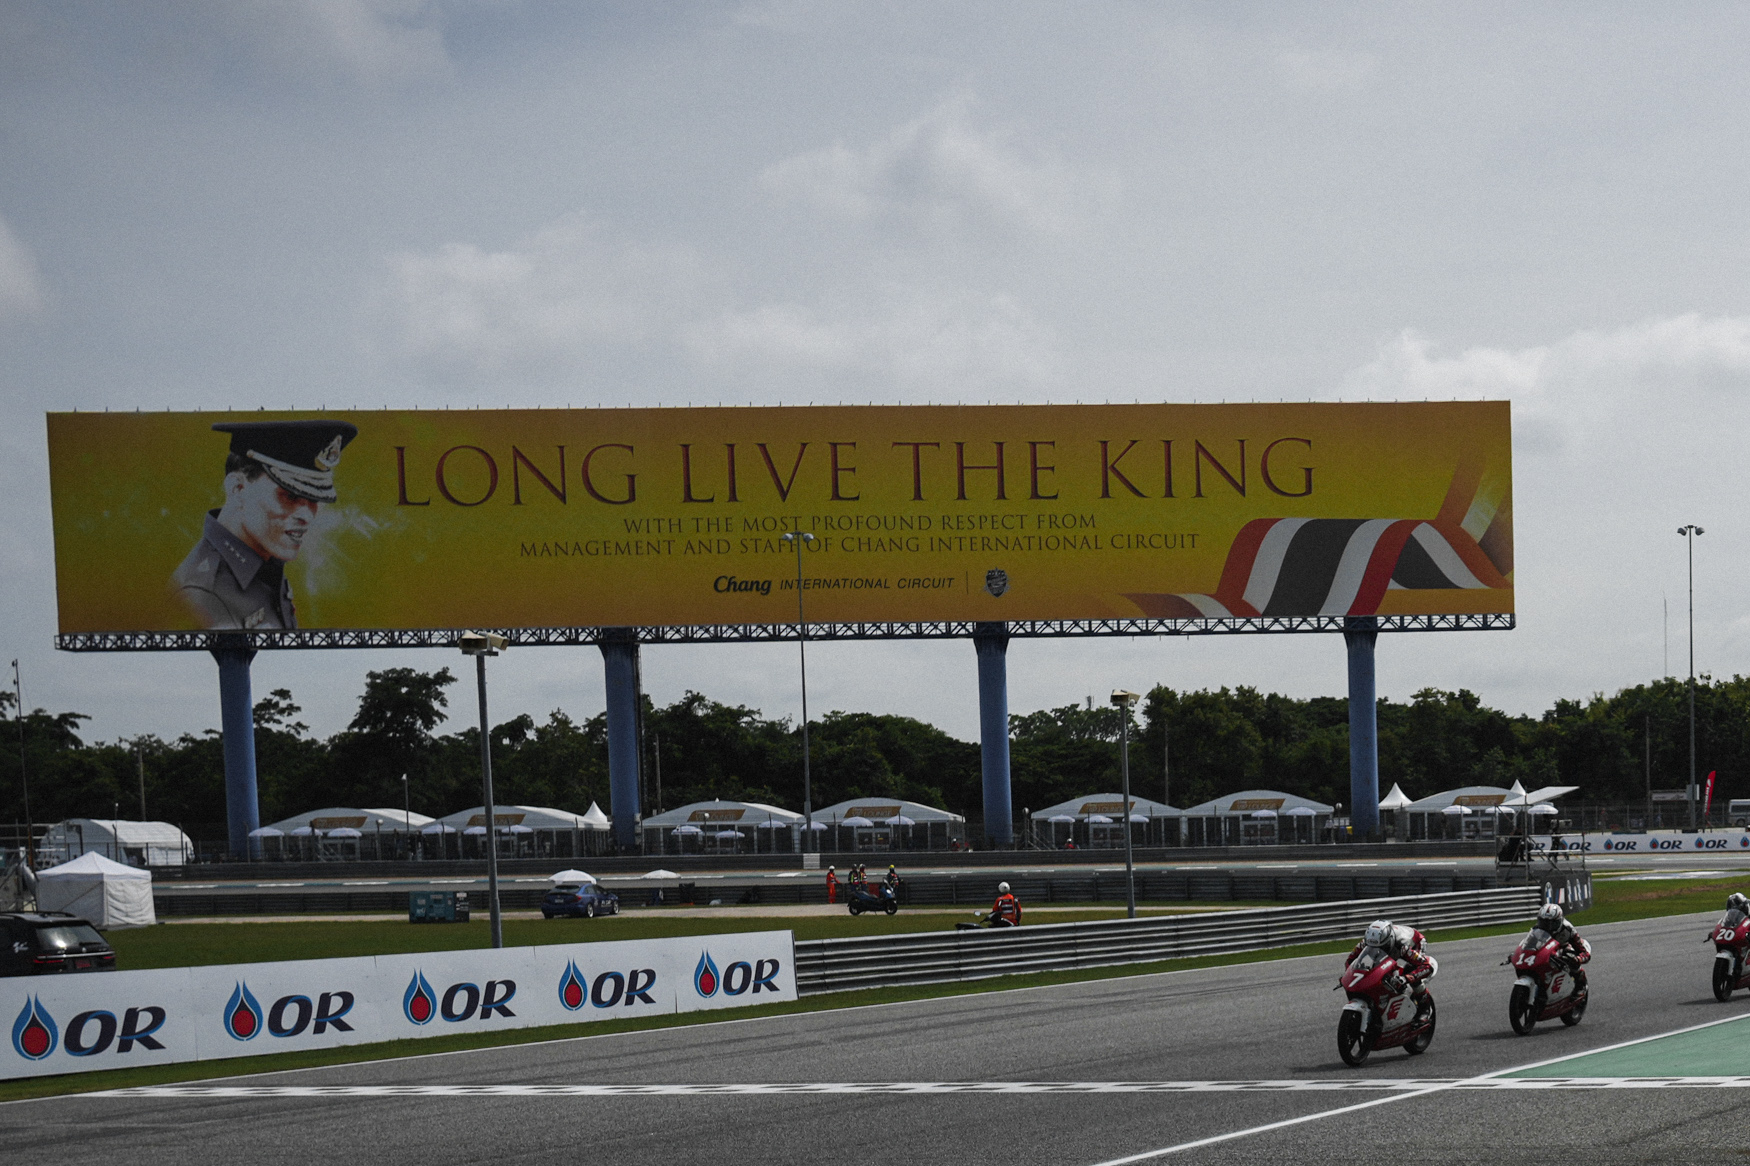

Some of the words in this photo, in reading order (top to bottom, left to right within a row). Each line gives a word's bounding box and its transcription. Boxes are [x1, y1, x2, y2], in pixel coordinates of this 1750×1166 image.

[394, 444, 636, 507] LONG
[679, 441, 860, 504] LIVE
[893, 440, 1059, 502] THE
[1099, 437, 1316, 500] KING
[623, 518, 682, 534] WITH
[691, 516, 734, 533] THE
[742, 516, 803, 531] MOST
[811, 514, 933, 531] PROFOUND
[941, 514, 1029, 530] RESPECT
[1037, 513, 1097, 529] FROM
[520, 538, 676, 557] MANAGEMENT
[684, 538, 732, 555] AND
[740, 537, 797, 554] STAFF
[806, 535, 833, 553] OF
[841, 535, 921, 553] CHANG
[929, 533, 1103, 551] INTERNATIONAL
[1111, 533, 1201, 550] CIRCUIT
[713, 575, 772, 596] Chang
[780, 577, 890, 592] INTERNATIONAL
[896, 576, 955, 590] CIRCUIT
[1613, 841, 1636, 850] OR
[1659, 839, 1682, 849] OR
[1704, 839, 1727, 848] OR
[1715, 928, 1735, 941] 20
[1515, 952, 1536, 967] 14
[1348, 972, 1365, 988] 7
[63, 1005, 165, 1056] OR
[267, 990, 354, 1037] OR
[440, 979, 516, 1022] OR
[590, 968, 656, 1008] OR
[722, 958, 779, 995] OR
